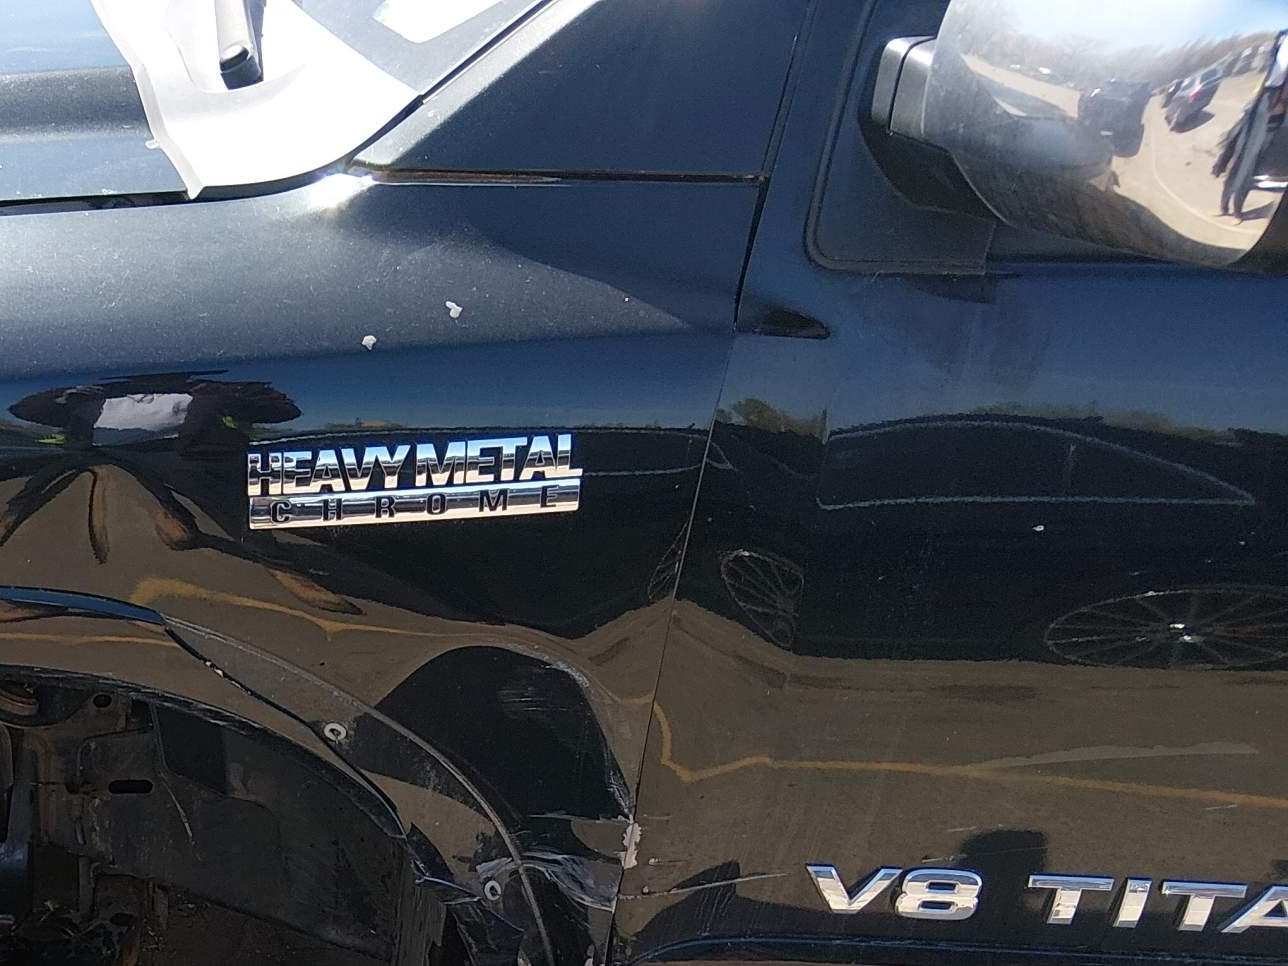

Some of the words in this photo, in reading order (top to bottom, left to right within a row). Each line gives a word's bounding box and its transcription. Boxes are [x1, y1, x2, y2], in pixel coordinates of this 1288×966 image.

[247, 443, 410, 496] HEAVY
[414, 433, 583, 487] METAL
[271, 485, 560, 524] CHROME
[806, 863, 982, 921] V8
